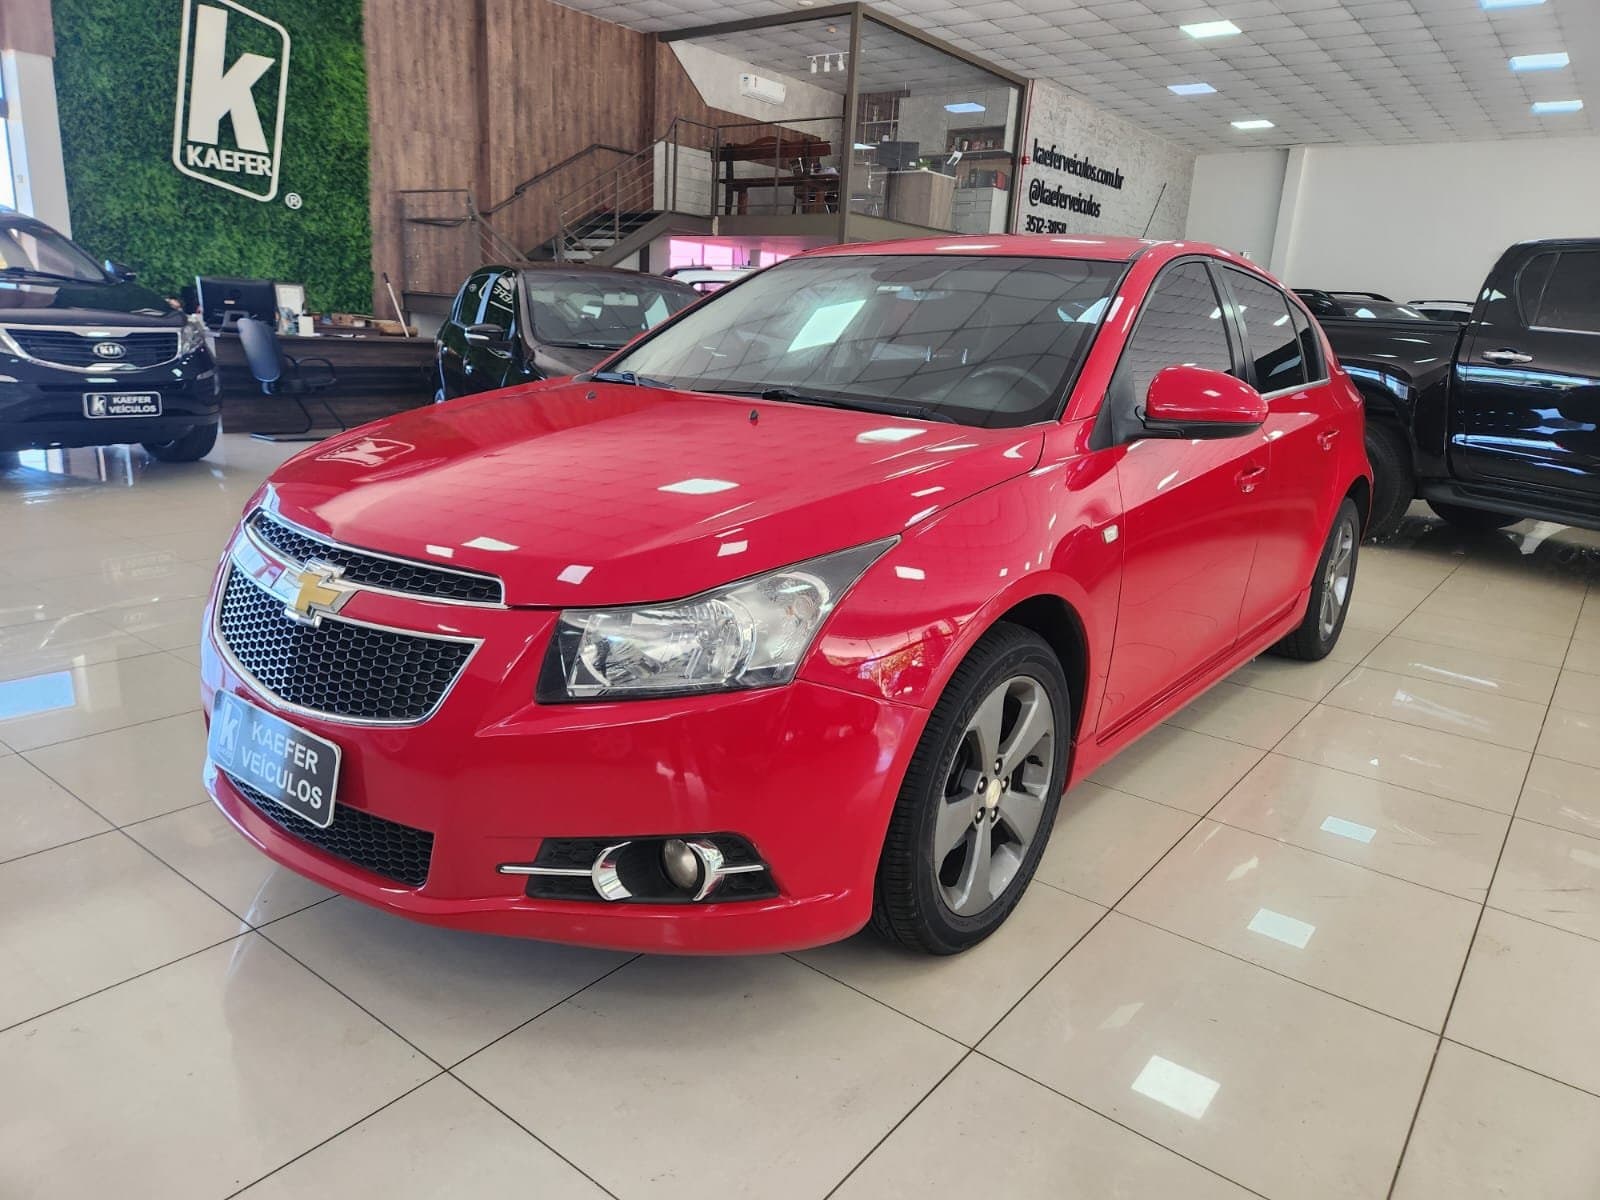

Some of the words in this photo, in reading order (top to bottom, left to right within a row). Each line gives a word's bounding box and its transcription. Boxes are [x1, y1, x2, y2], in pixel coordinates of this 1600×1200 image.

[186, 144, 272, 177] KAEFER
[1033, 138, 1124, 190] kaeferveiculos.com.br
[1029, 178, 1101, 218] @kaeferveiculos
[100, 345, 122, 355] KIA
[112, 396, 152, 404] KAEFER
[252, 720, 319, 775] KAEFER
[241, 746, 323, 810] VEÍCULOS
